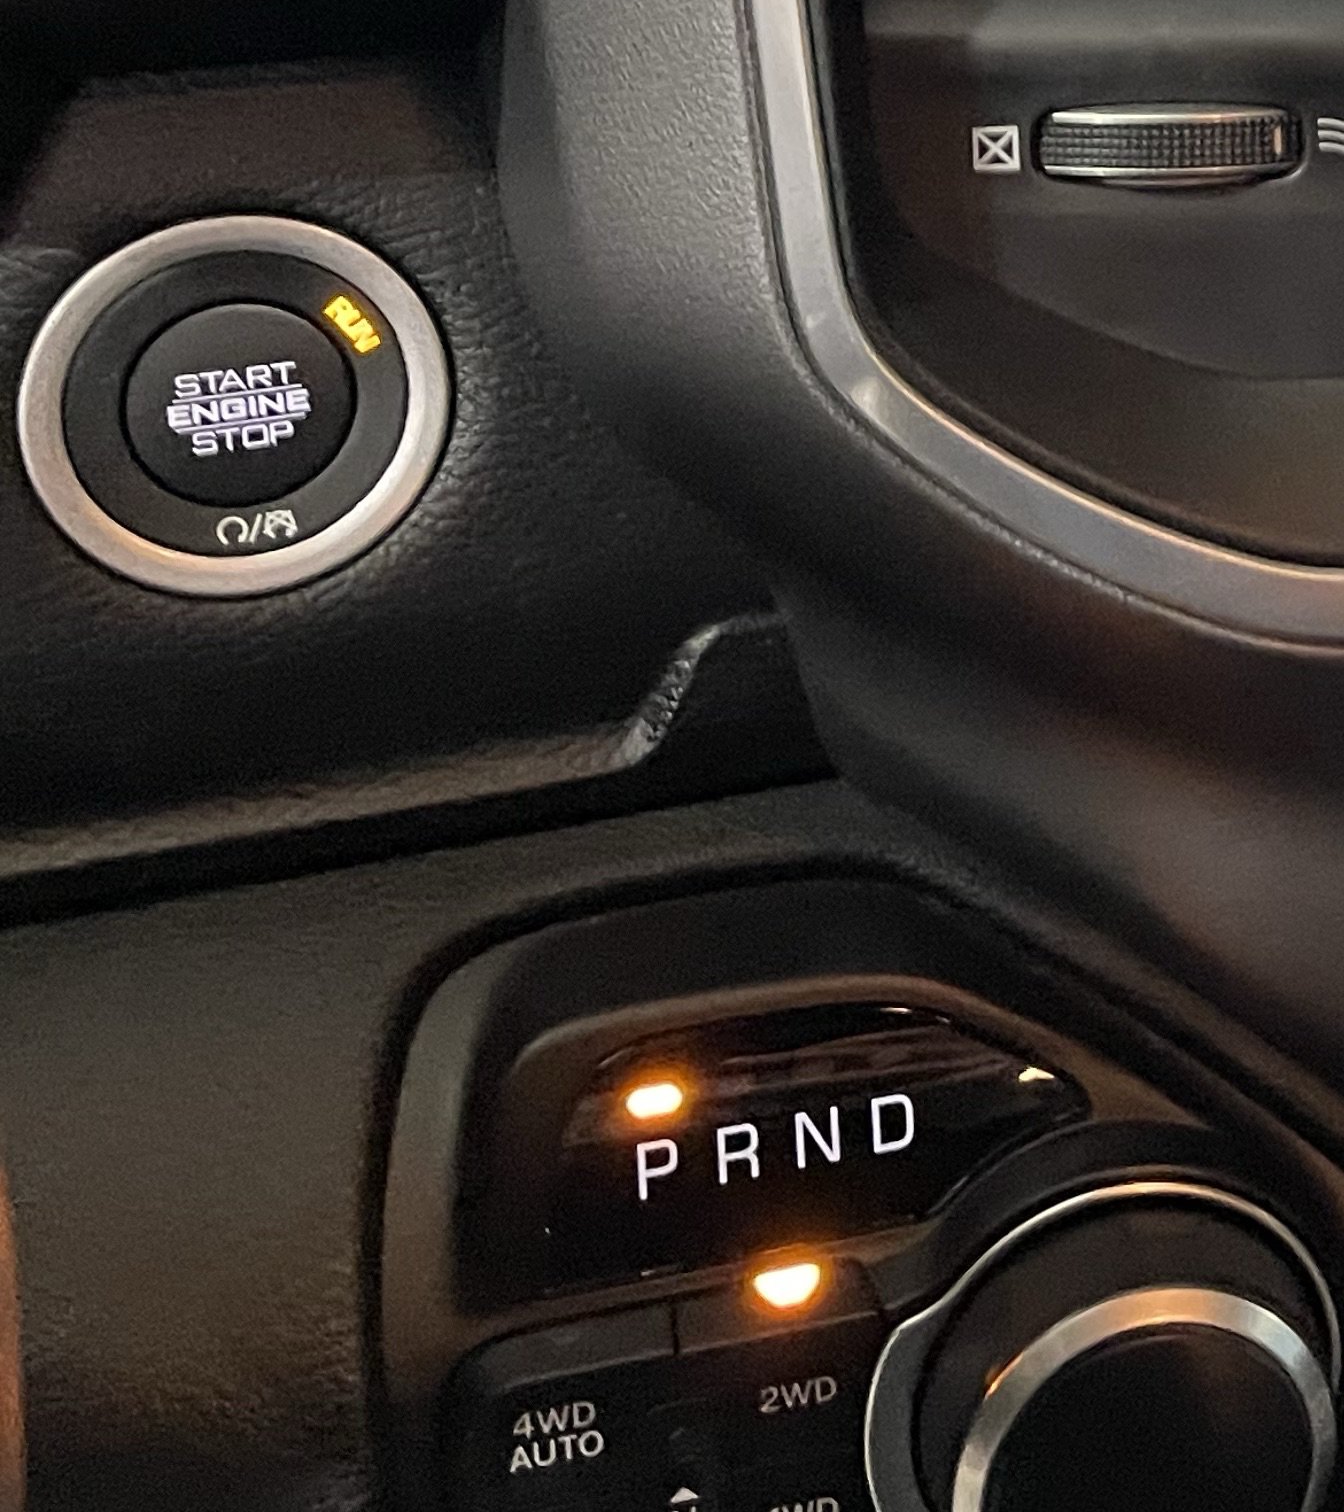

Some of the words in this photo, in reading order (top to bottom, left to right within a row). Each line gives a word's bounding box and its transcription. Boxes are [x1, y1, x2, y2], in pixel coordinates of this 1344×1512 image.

[322, 294, 382, 354] RUN
[173, 360, 297, 399] START
[166, 388, 312, 431] ENGINE
[192, 420, 295, 457] STOP
[636, 1137, 679, 1201] P
[715, 1121, 760, 1186] R
[794, 1105, 842, 1170] N
[870, 1092, 915, 1155] D
[758, 1374, 838, 1414] 2WD
[512, 1399, 597, 1440] 4WD
[509, 1429, 605, 1475] AUTO
